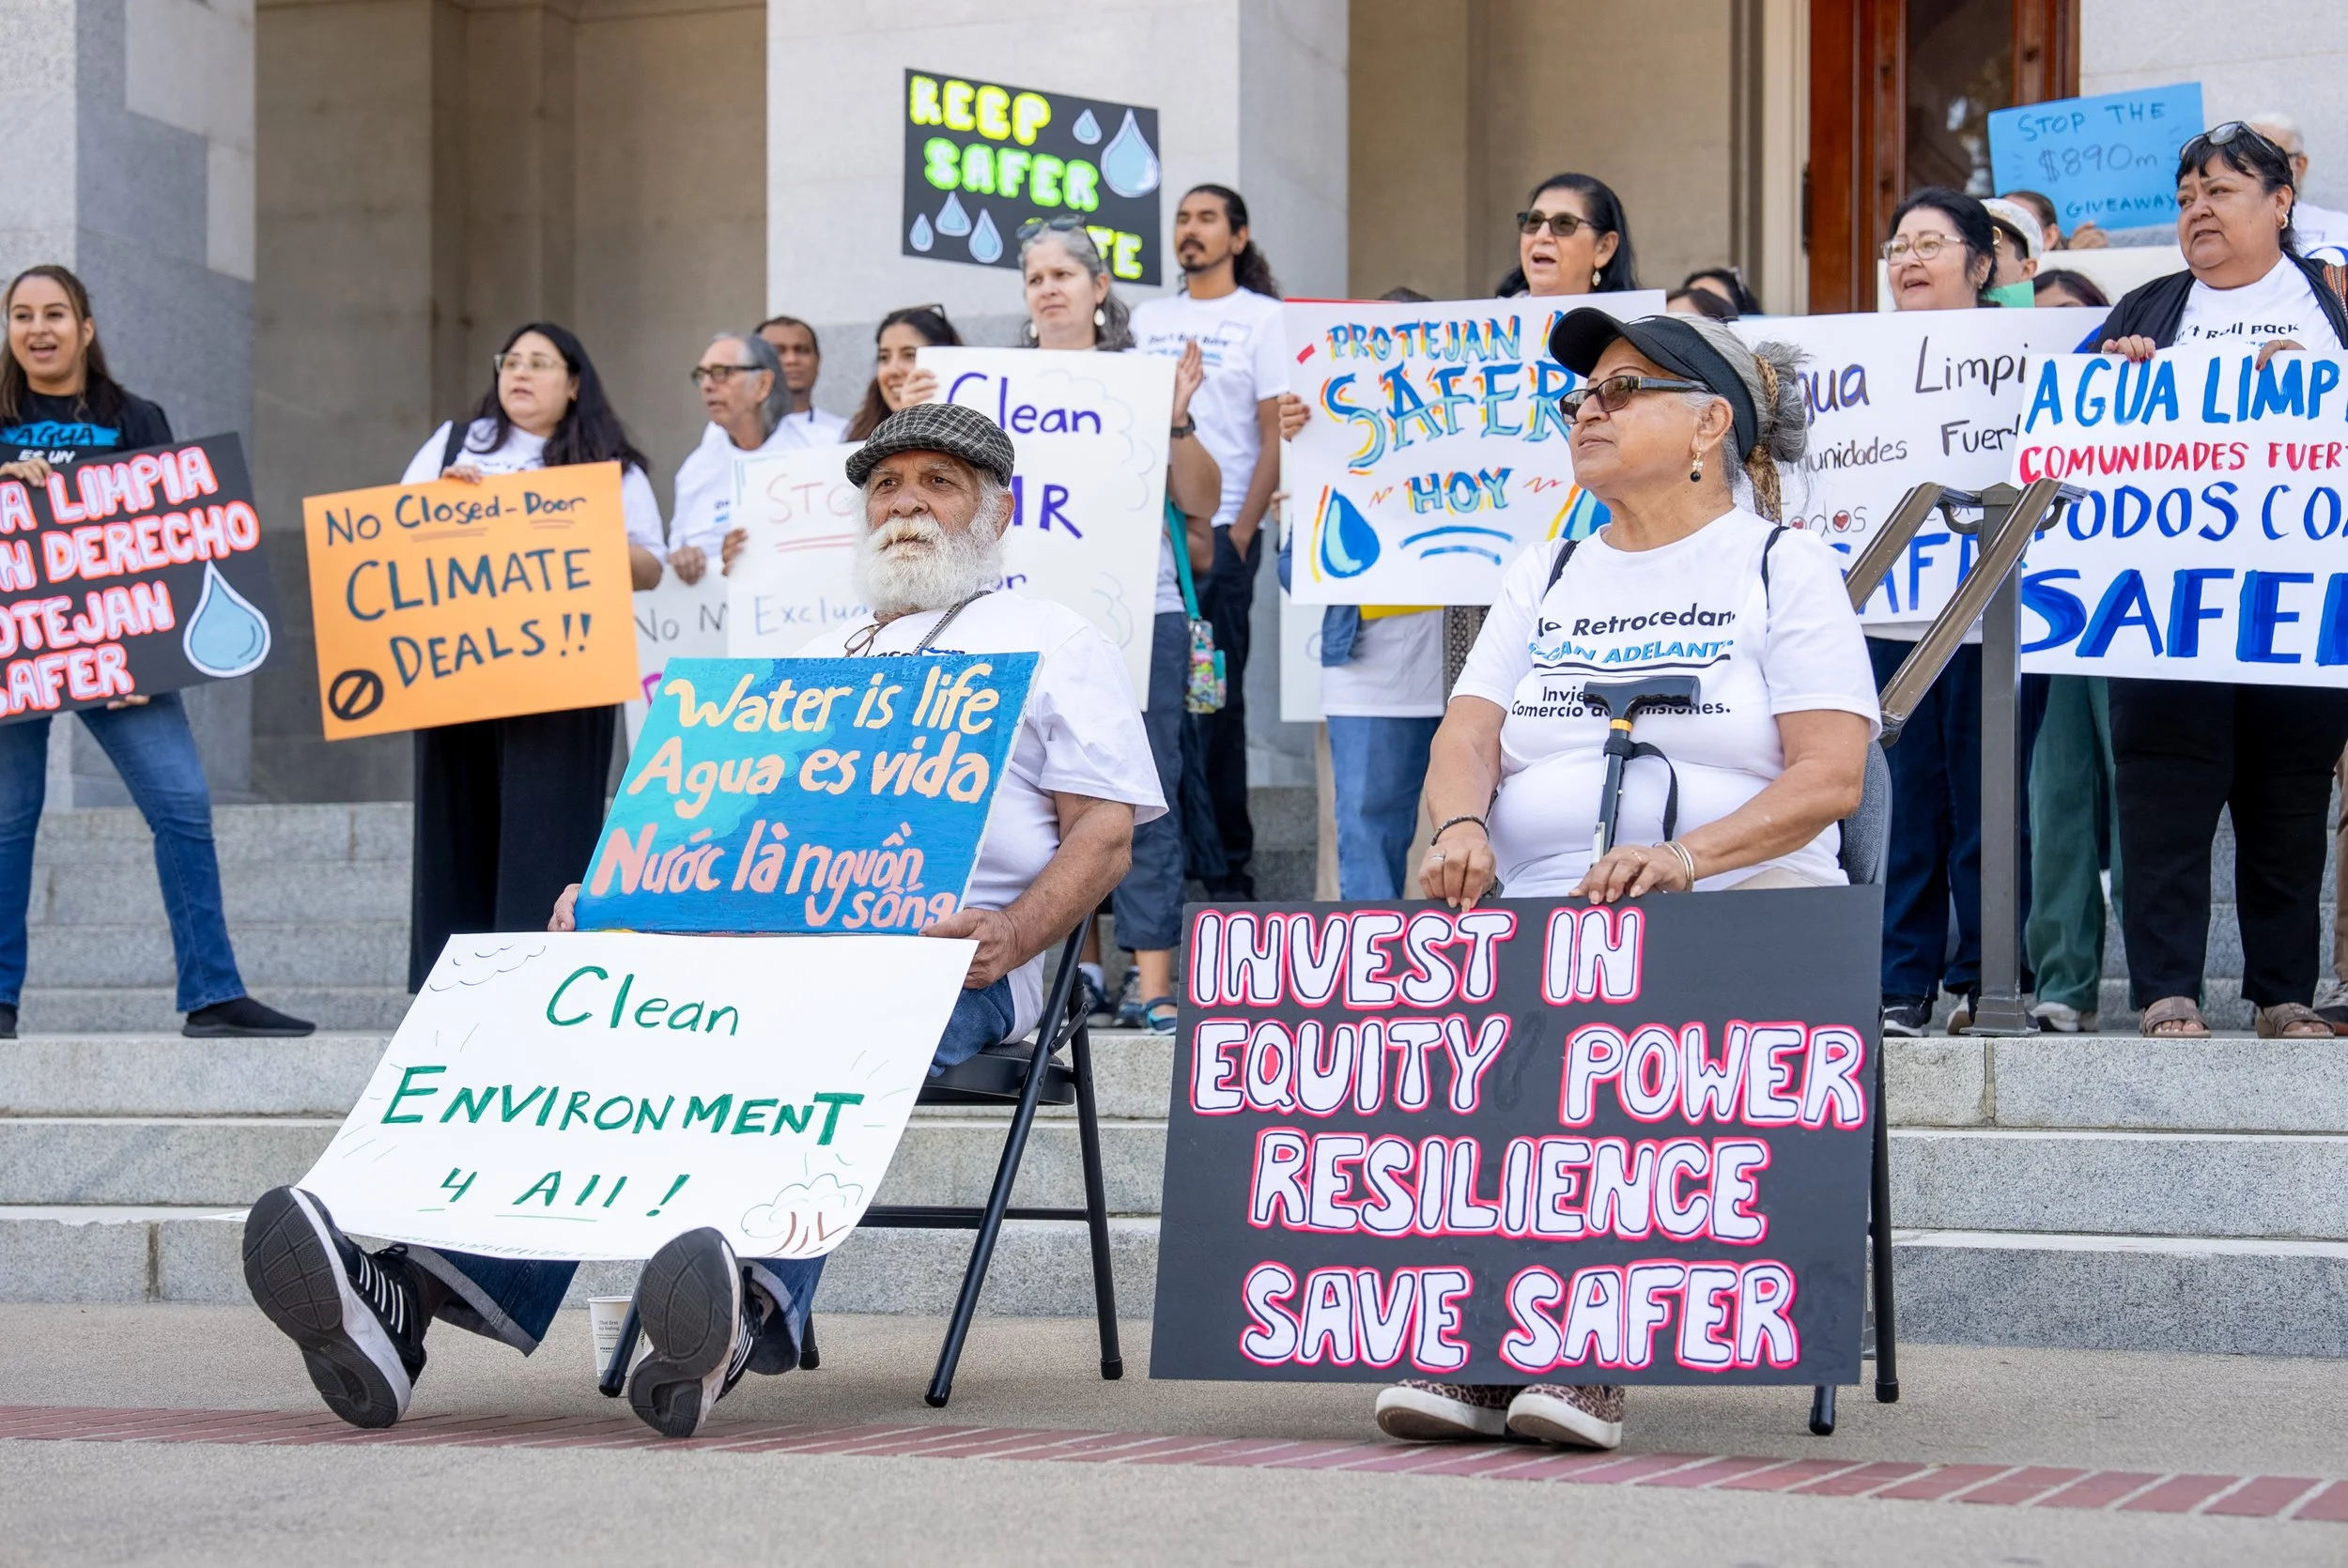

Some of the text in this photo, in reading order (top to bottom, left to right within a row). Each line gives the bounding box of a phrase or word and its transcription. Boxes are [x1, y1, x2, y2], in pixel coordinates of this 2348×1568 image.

[909, 74, 1051, 146] KEEP
[2017, 101, 2165, 142] STOP THE
[923, 136, 1099, 212] SAFER
[2038, 143, 2157, 183] $890m
[1326, 315, 1522, 362] PROTEJAN
[1320, 359, 1576, 475] SAFER
[2025, 355, 2348, 435] AGUA LIMP
[13, 424, 95, 447] AGUA
[47, 450, 76, 465] UN
[2019, 440, 2348, 485] COMUNIDADES FUER
[46, 446, 219, 525] LIMPIA
[1403, 466, 1515, 515] HOY
[1781, 499, 1867, 537] odos
[2033, 480, 2348, 543] ODOS CO
[40, 500, 260, 584] DERECHO
[346, 547, 592, 623] CLIMATE
[0, 642, 135, 719] AFER
[1602, 639, 1735, 664] ADELANT
[664, 673, 854, 733] Water
[853, 672, 903, 730] is
[911, 663, 1000, 735] life
[1511, 699, 1584, 718] Comercio
[626, 730, 990, 820] Agua es vida
[732, 819, 790, 895] là
[1189, 905, 1646, 1010] INVEST IN
[546, 964, 739, 1038] Clean
[379, 1063, 865, 1146] ENVIRONMENT
[1190, 1012, 1867, 1130] EQUITY POWER
[440, 1167, 477, 1203] 4
[1247, 1127, 1773, 1245] RESILIENCE
[1239, 1258, 1800, 1373] SAVE SAFER
